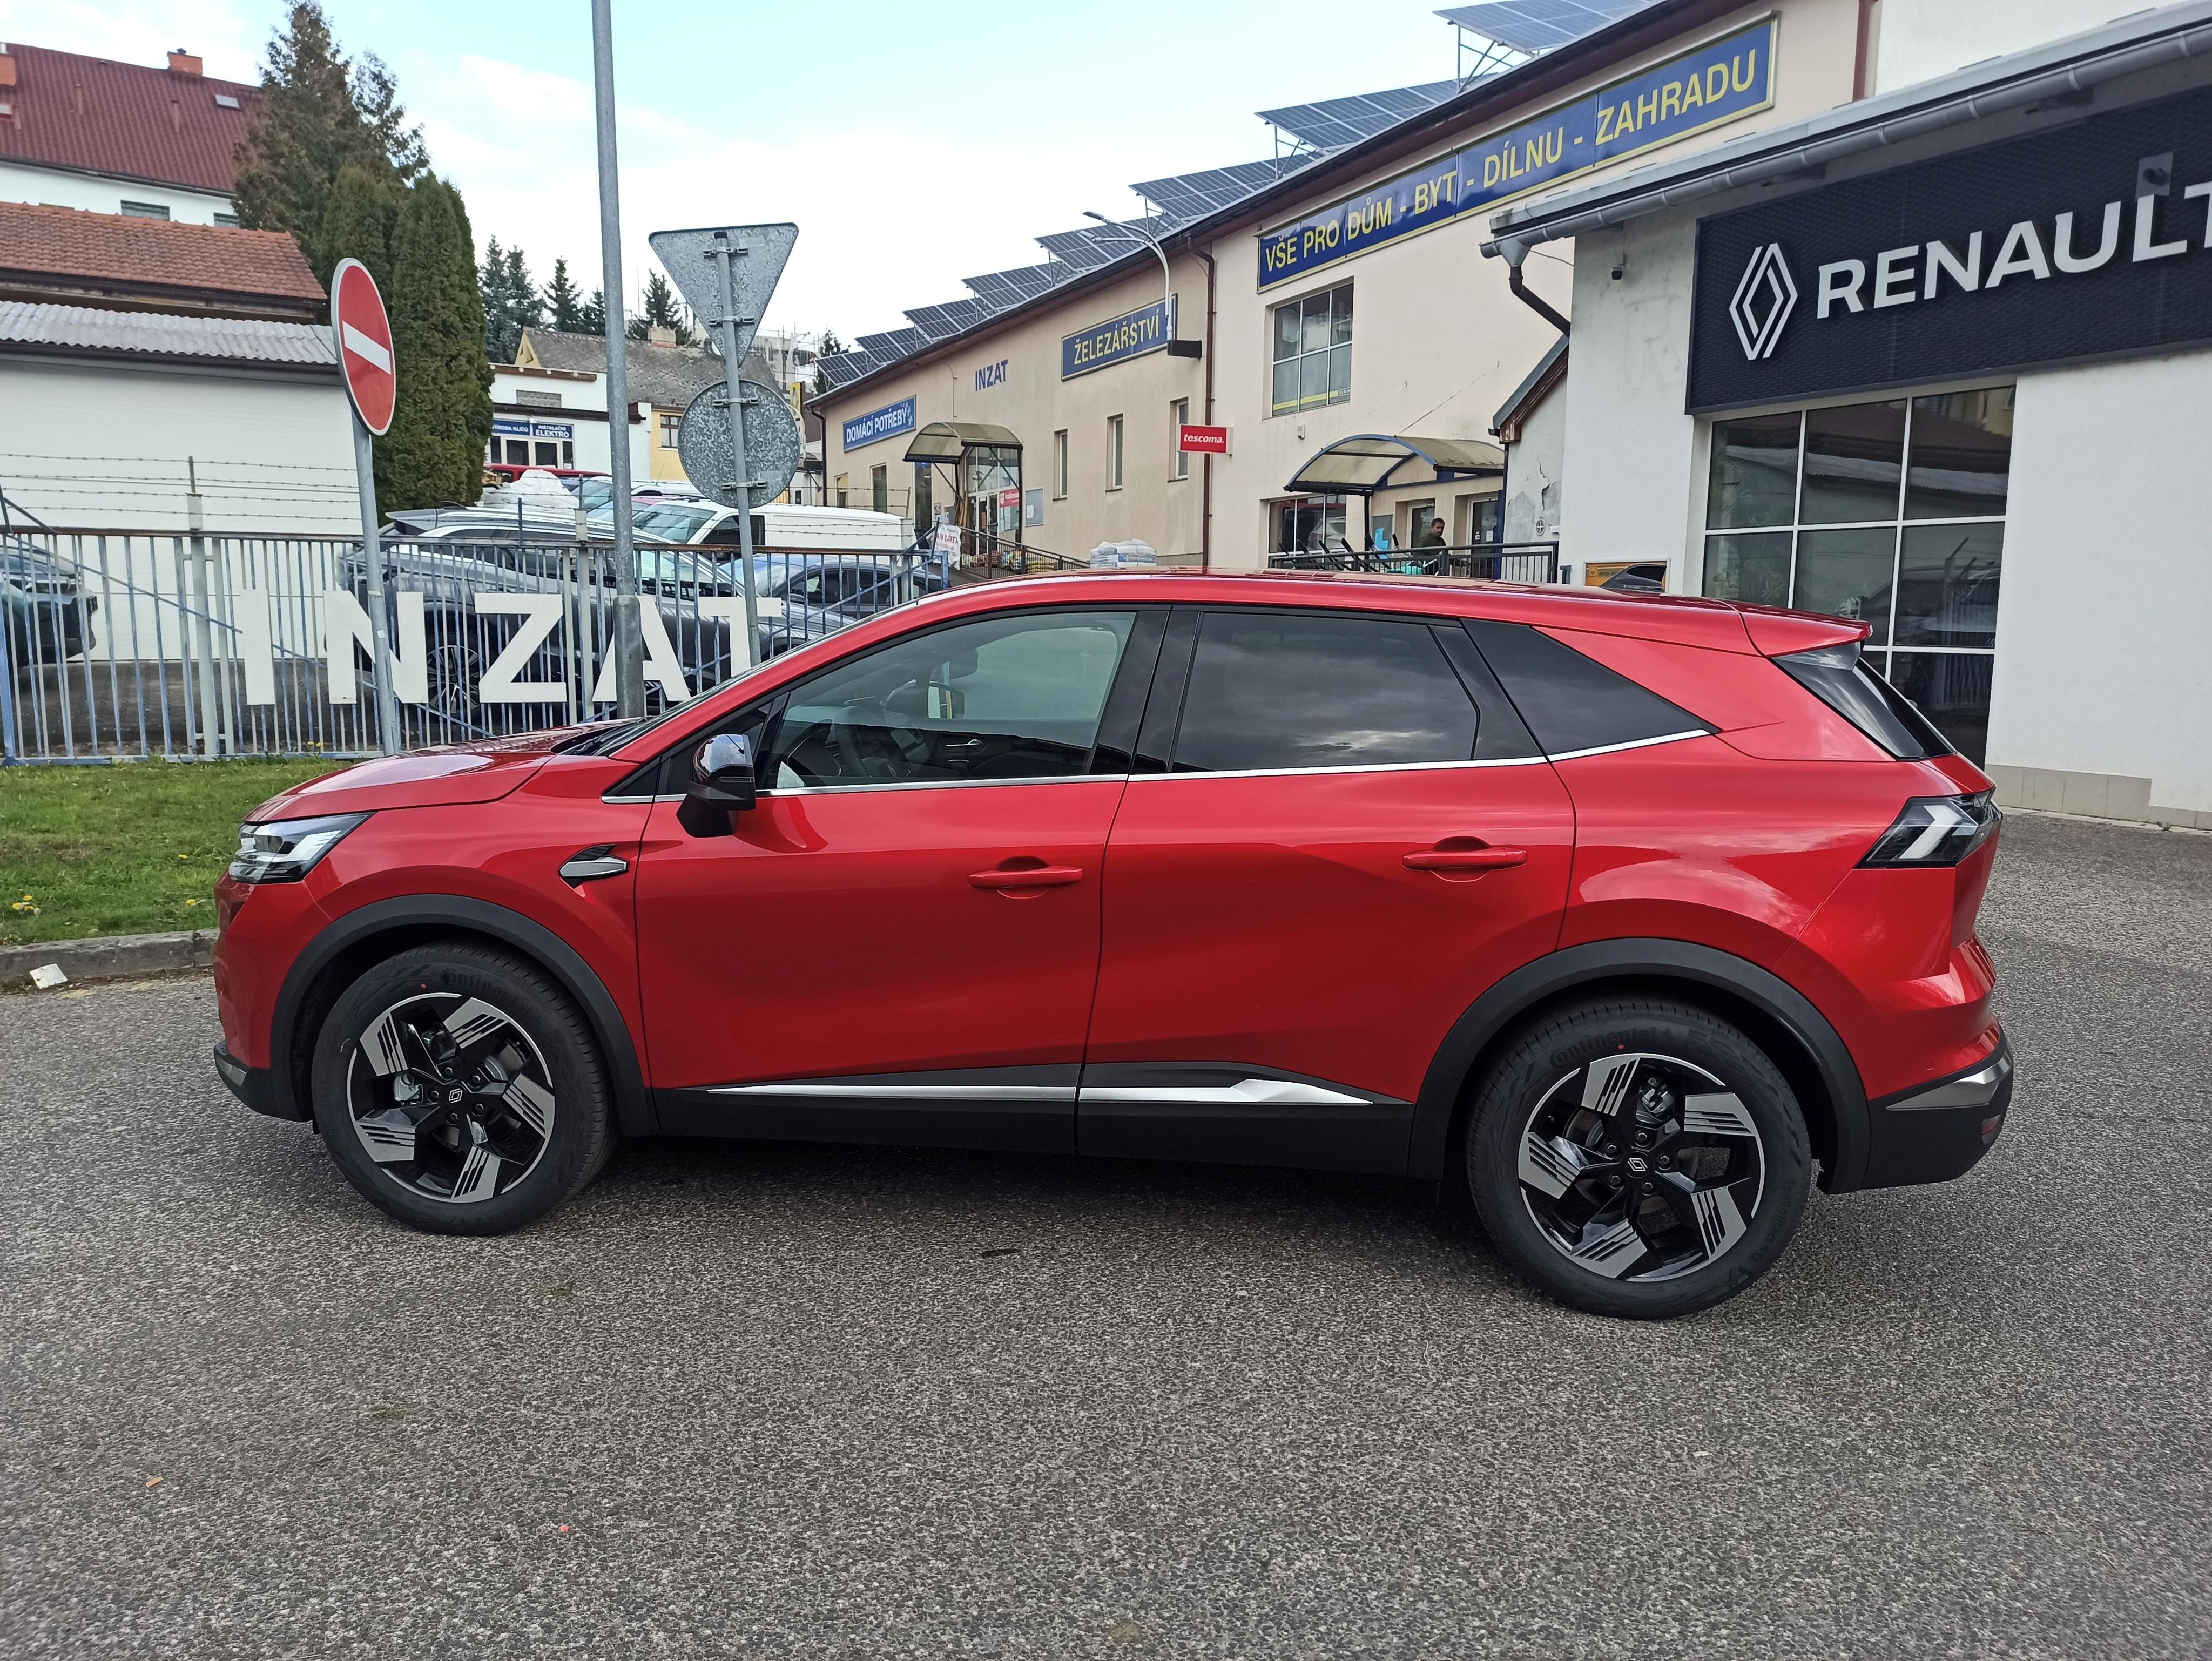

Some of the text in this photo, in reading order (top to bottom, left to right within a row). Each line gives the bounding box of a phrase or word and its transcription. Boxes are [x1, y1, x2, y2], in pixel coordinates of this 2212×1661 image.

[1265, 235, 1297, 272] VŠE
[1303, 219, 1340, 258] PRO
[1347, 197, 1392, 241] DŮM
[1414, 171, 1457, 215] BYT
[1483, 127, 1563, 188] DÍLNU
[1595, 49, 1756, 146] ZAHRADU
[1074, 308, 1160, 366] ŽELEZÁŘSTVÍ
[975, 359, 1008, 391] INZAT
[535, 429, 570, 438] ELEKTRO
[846, 406, 908, 443] DOMÁCÍ POTŘEBY
[240, 589, 783, 705] INZAT
[1549, 1027, 1657, 1068] Continental
